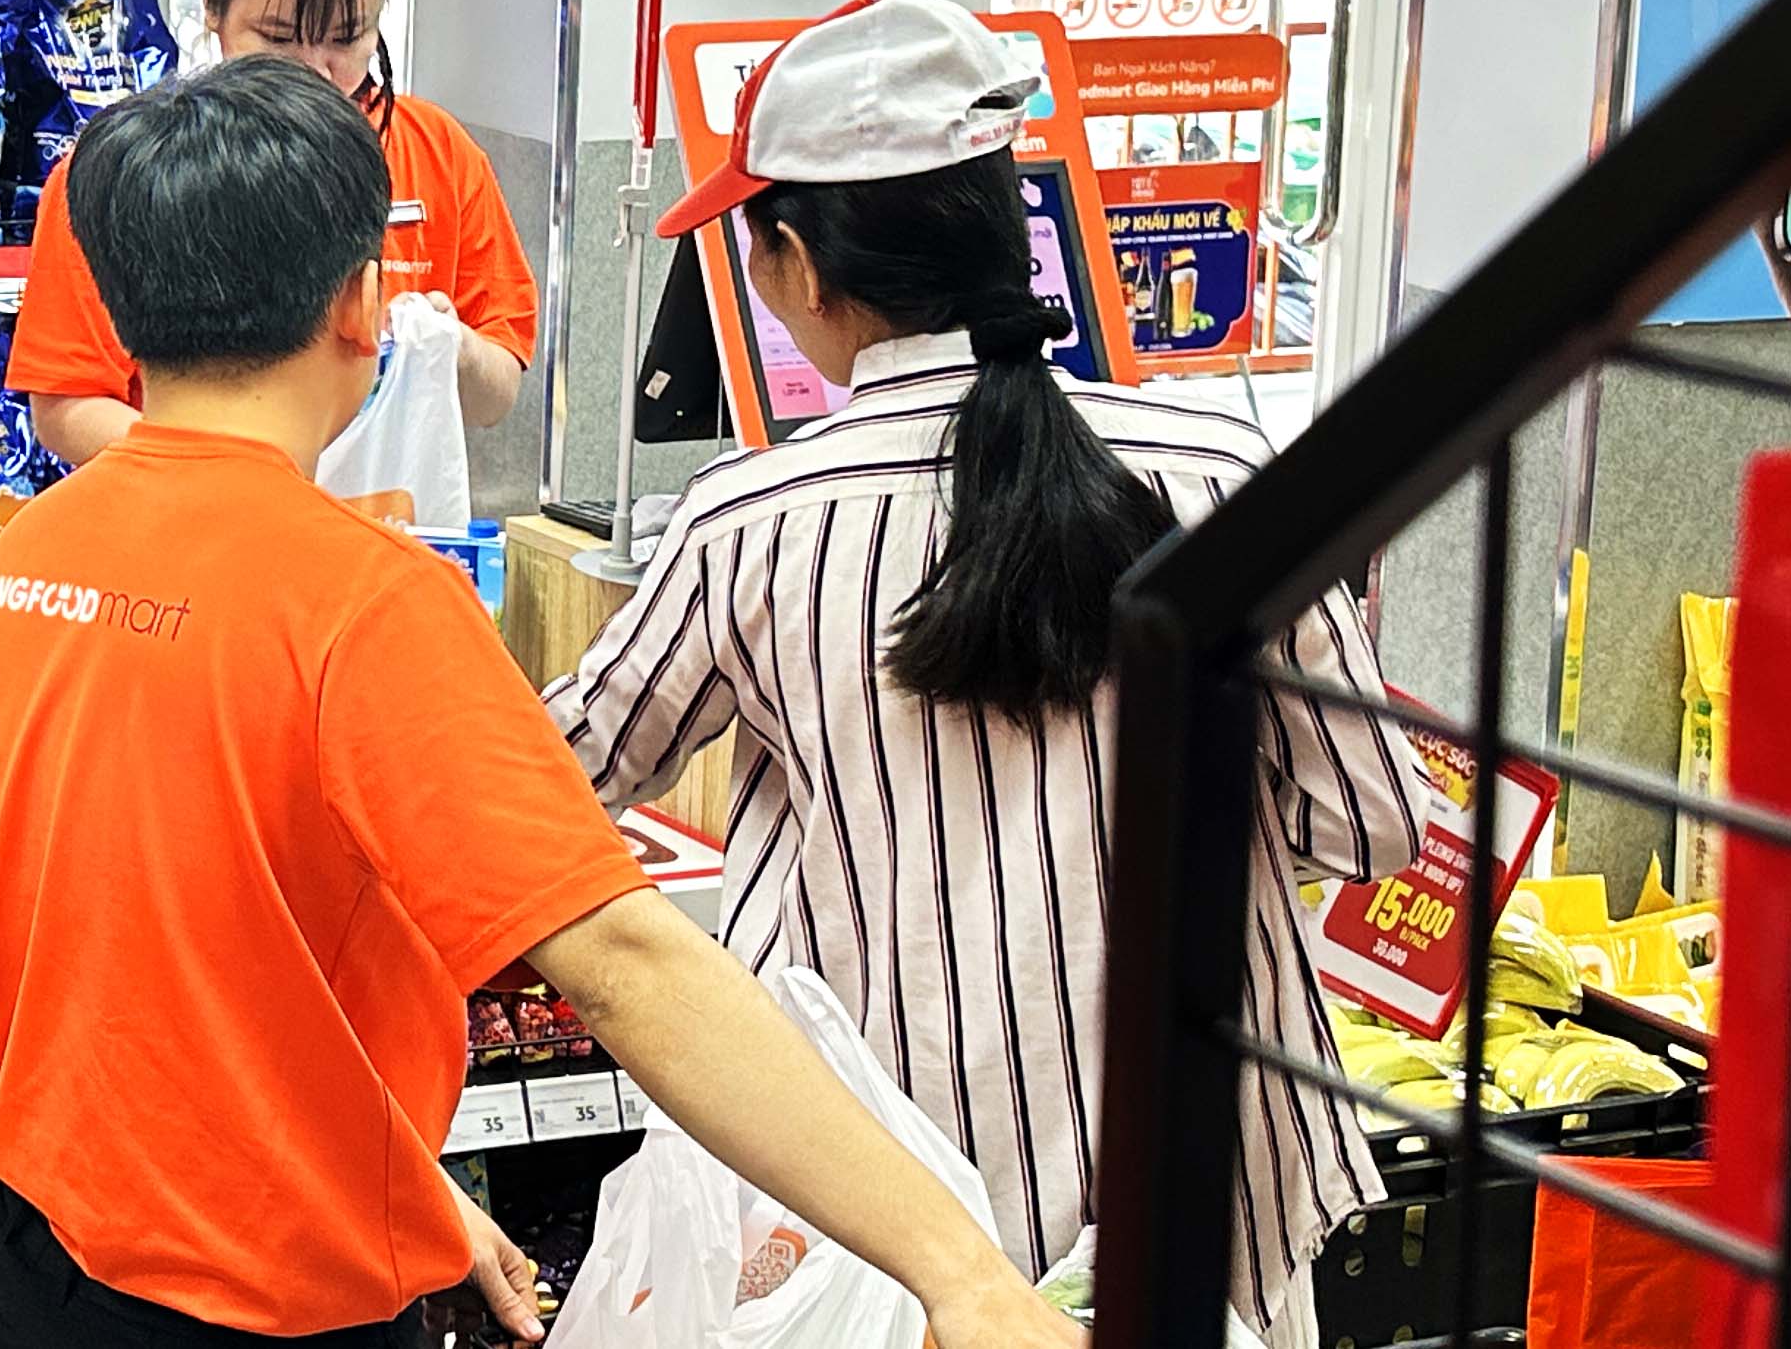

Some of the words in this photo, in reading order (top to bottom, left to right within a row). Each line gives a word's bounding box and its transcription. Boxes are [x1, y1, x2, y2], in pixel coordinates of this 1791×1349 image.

[1135, 81, 1168, 98] Giao
[1171, 79, 1210, 98] Hàng
[1213, 78, 1248, 95] Miễn
[1251, 76, 1276, 92] Phí
[1364, 876, 1456, 941] 15.000
[576, 1106, 596, 1122] 35
[482, 1116, 504, 1133] 35
